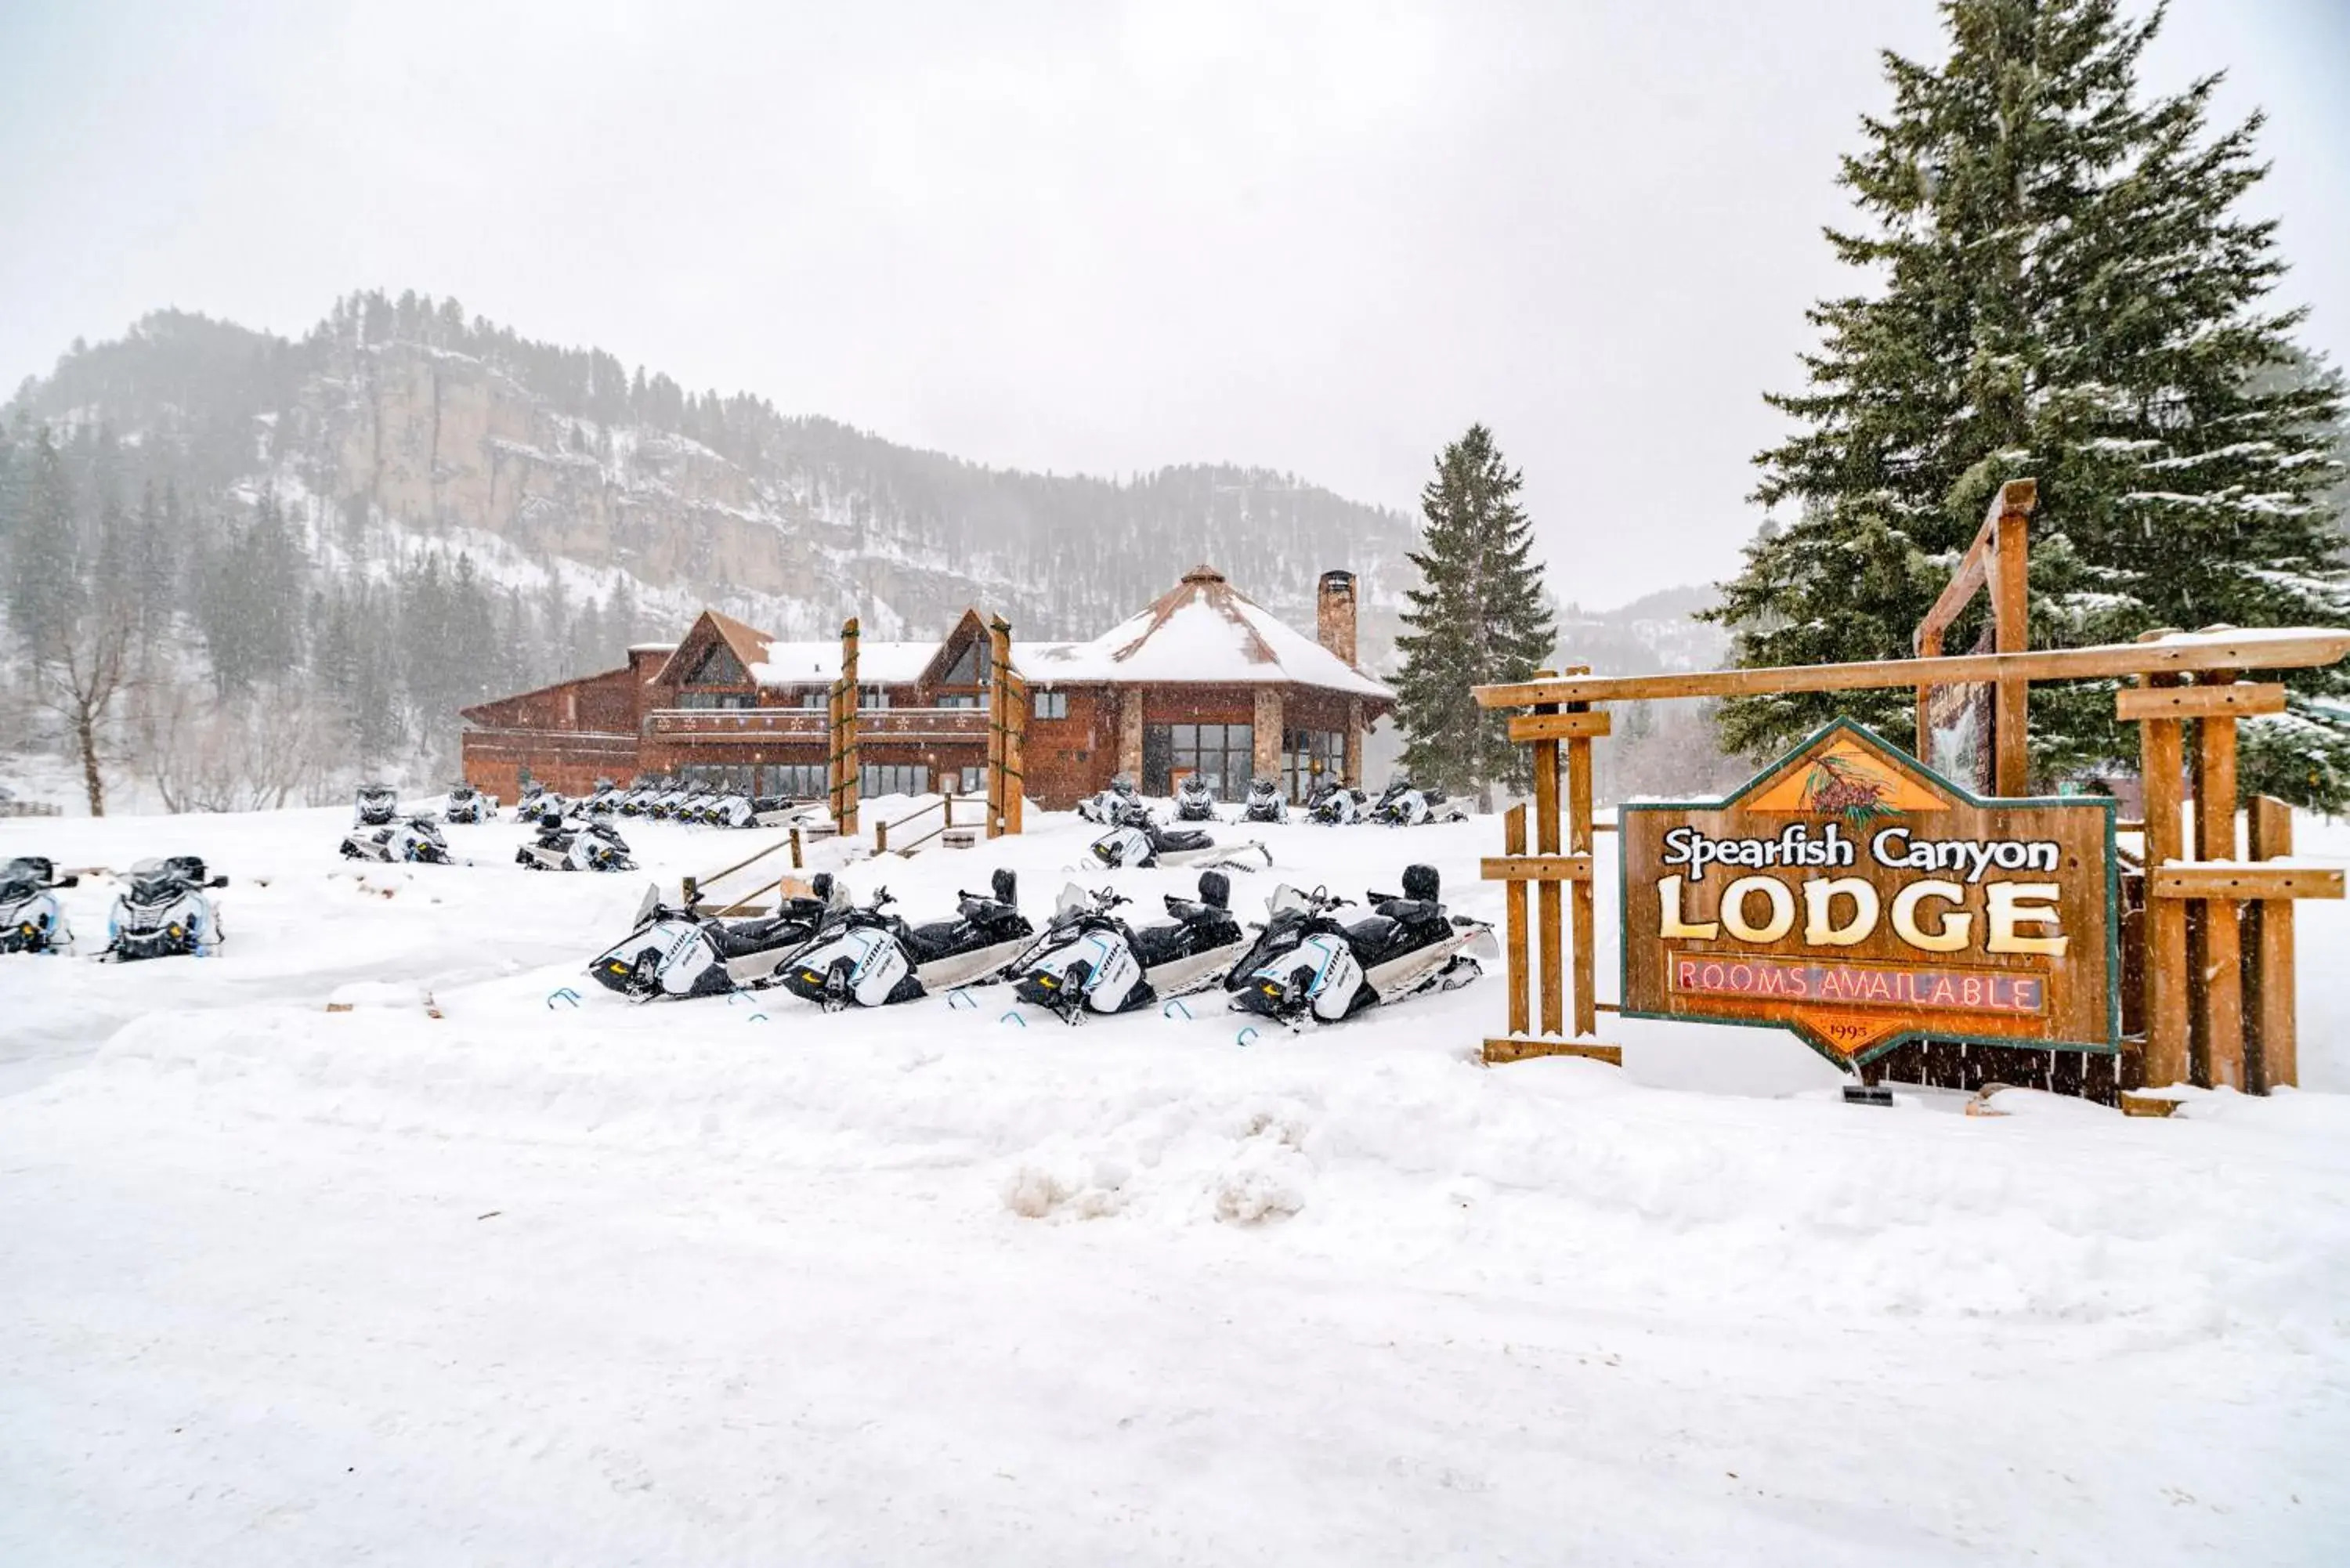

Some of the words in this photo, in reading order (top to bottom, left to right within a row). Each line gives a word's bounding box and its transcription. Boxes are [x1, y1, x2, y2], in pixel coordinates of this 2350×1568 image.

[1663, 822, 1856, 882] Spearfish
[1869, 826, 2062, 883] Canyon
[1657, 873, 2069, 956] LODGE
[1679, 960, 1807, 995] ROOMS
[1820, 969, 2041, 1010] AVAILABLE
